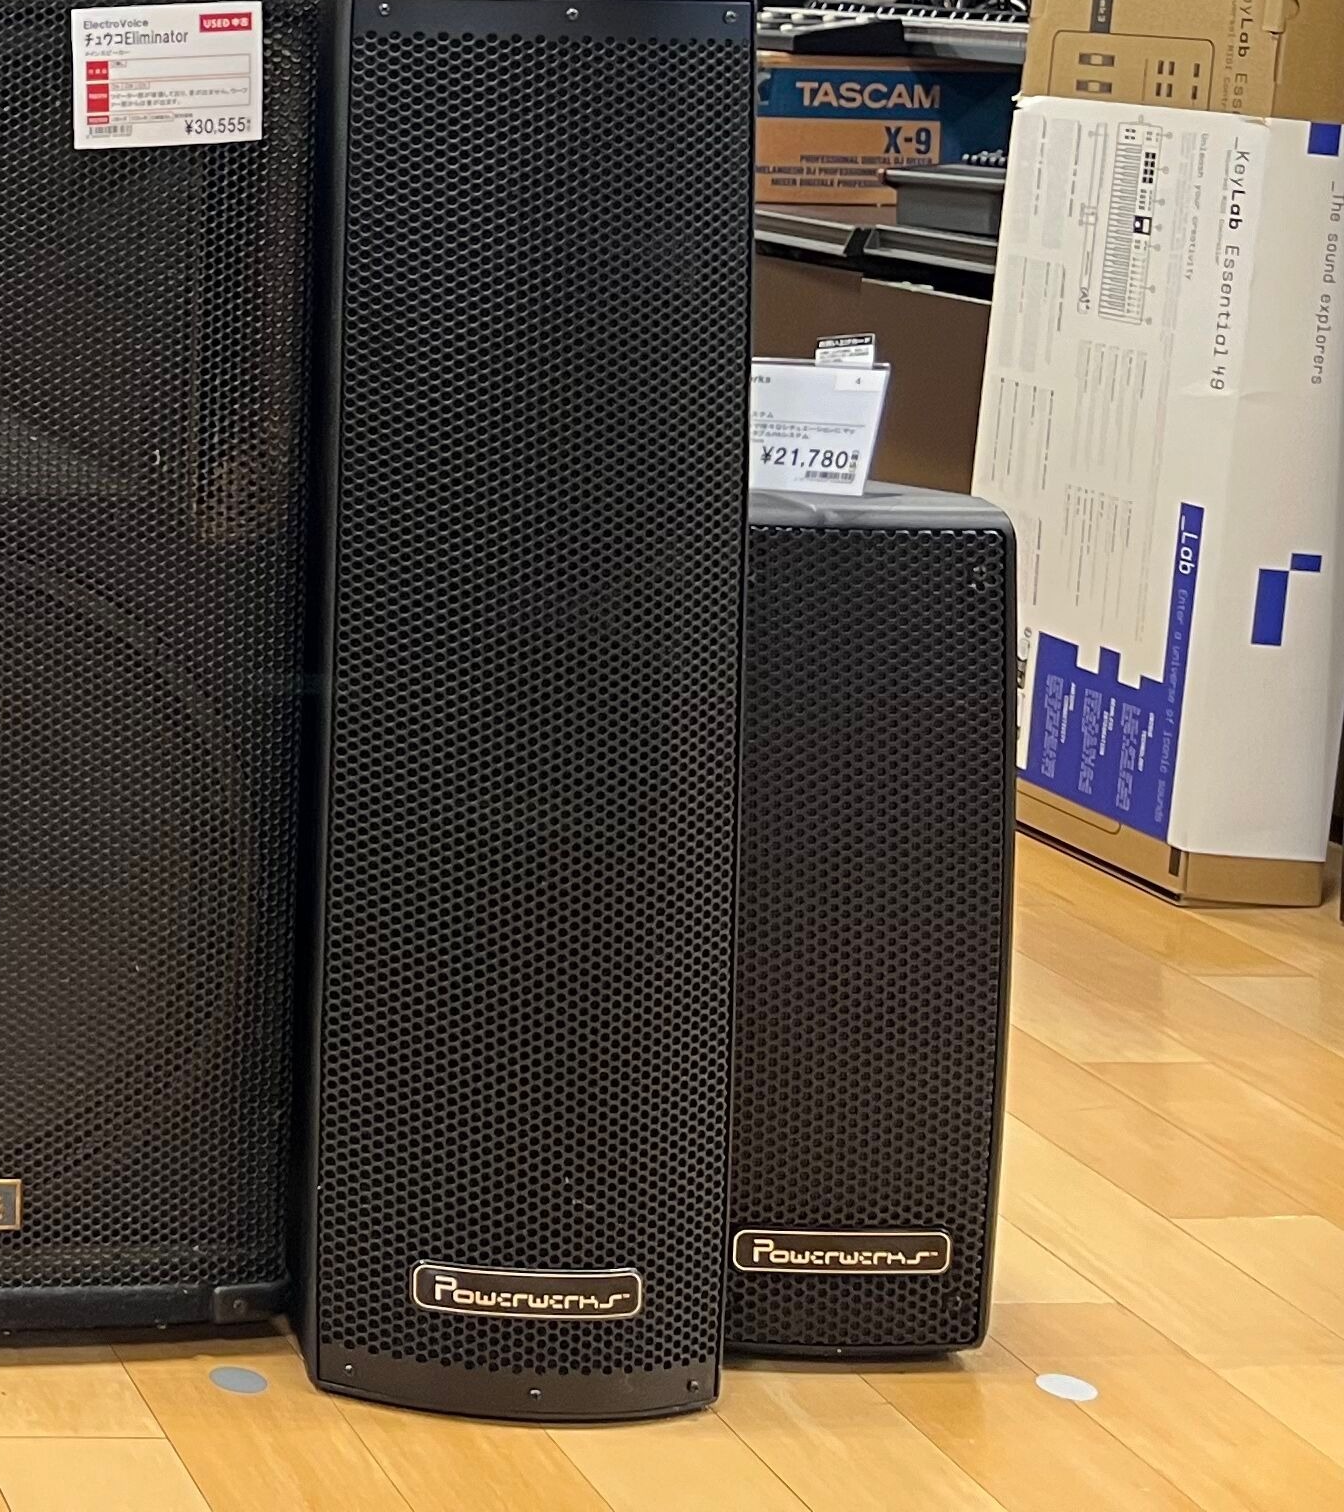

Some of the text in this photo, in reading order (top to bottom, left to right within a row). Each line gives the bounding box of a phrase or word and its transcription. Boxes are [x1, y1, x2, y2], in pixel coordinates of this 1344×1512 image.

[83, 18, 149, 30] ElectroVoice
[202, 17, 249, 29] USED 中古
[84, 30, 189, 48] チュウコEliminator
[795, 81, 941, 109] TASCAM
[184, 116, 247, 135] ¥30,555
[883, 125, 932, 155] X-9
[799, 154, 858, 164] PROFESSIONAL
[1322, 233, 1339, 284] sound
[1213, 244, 1239, 358] Essential
[1311, 293, 1332, 385] explorers
[1209, 364, 1226, 391] 49
[761, 446, 849, 469] ¥21,780
[1175, 588, 1188, 625] Enter
[1166, 644, 1182, 704] universe
[1164, 708, 1175, 725] of
[1159, 730, 1174, 775] iconic
